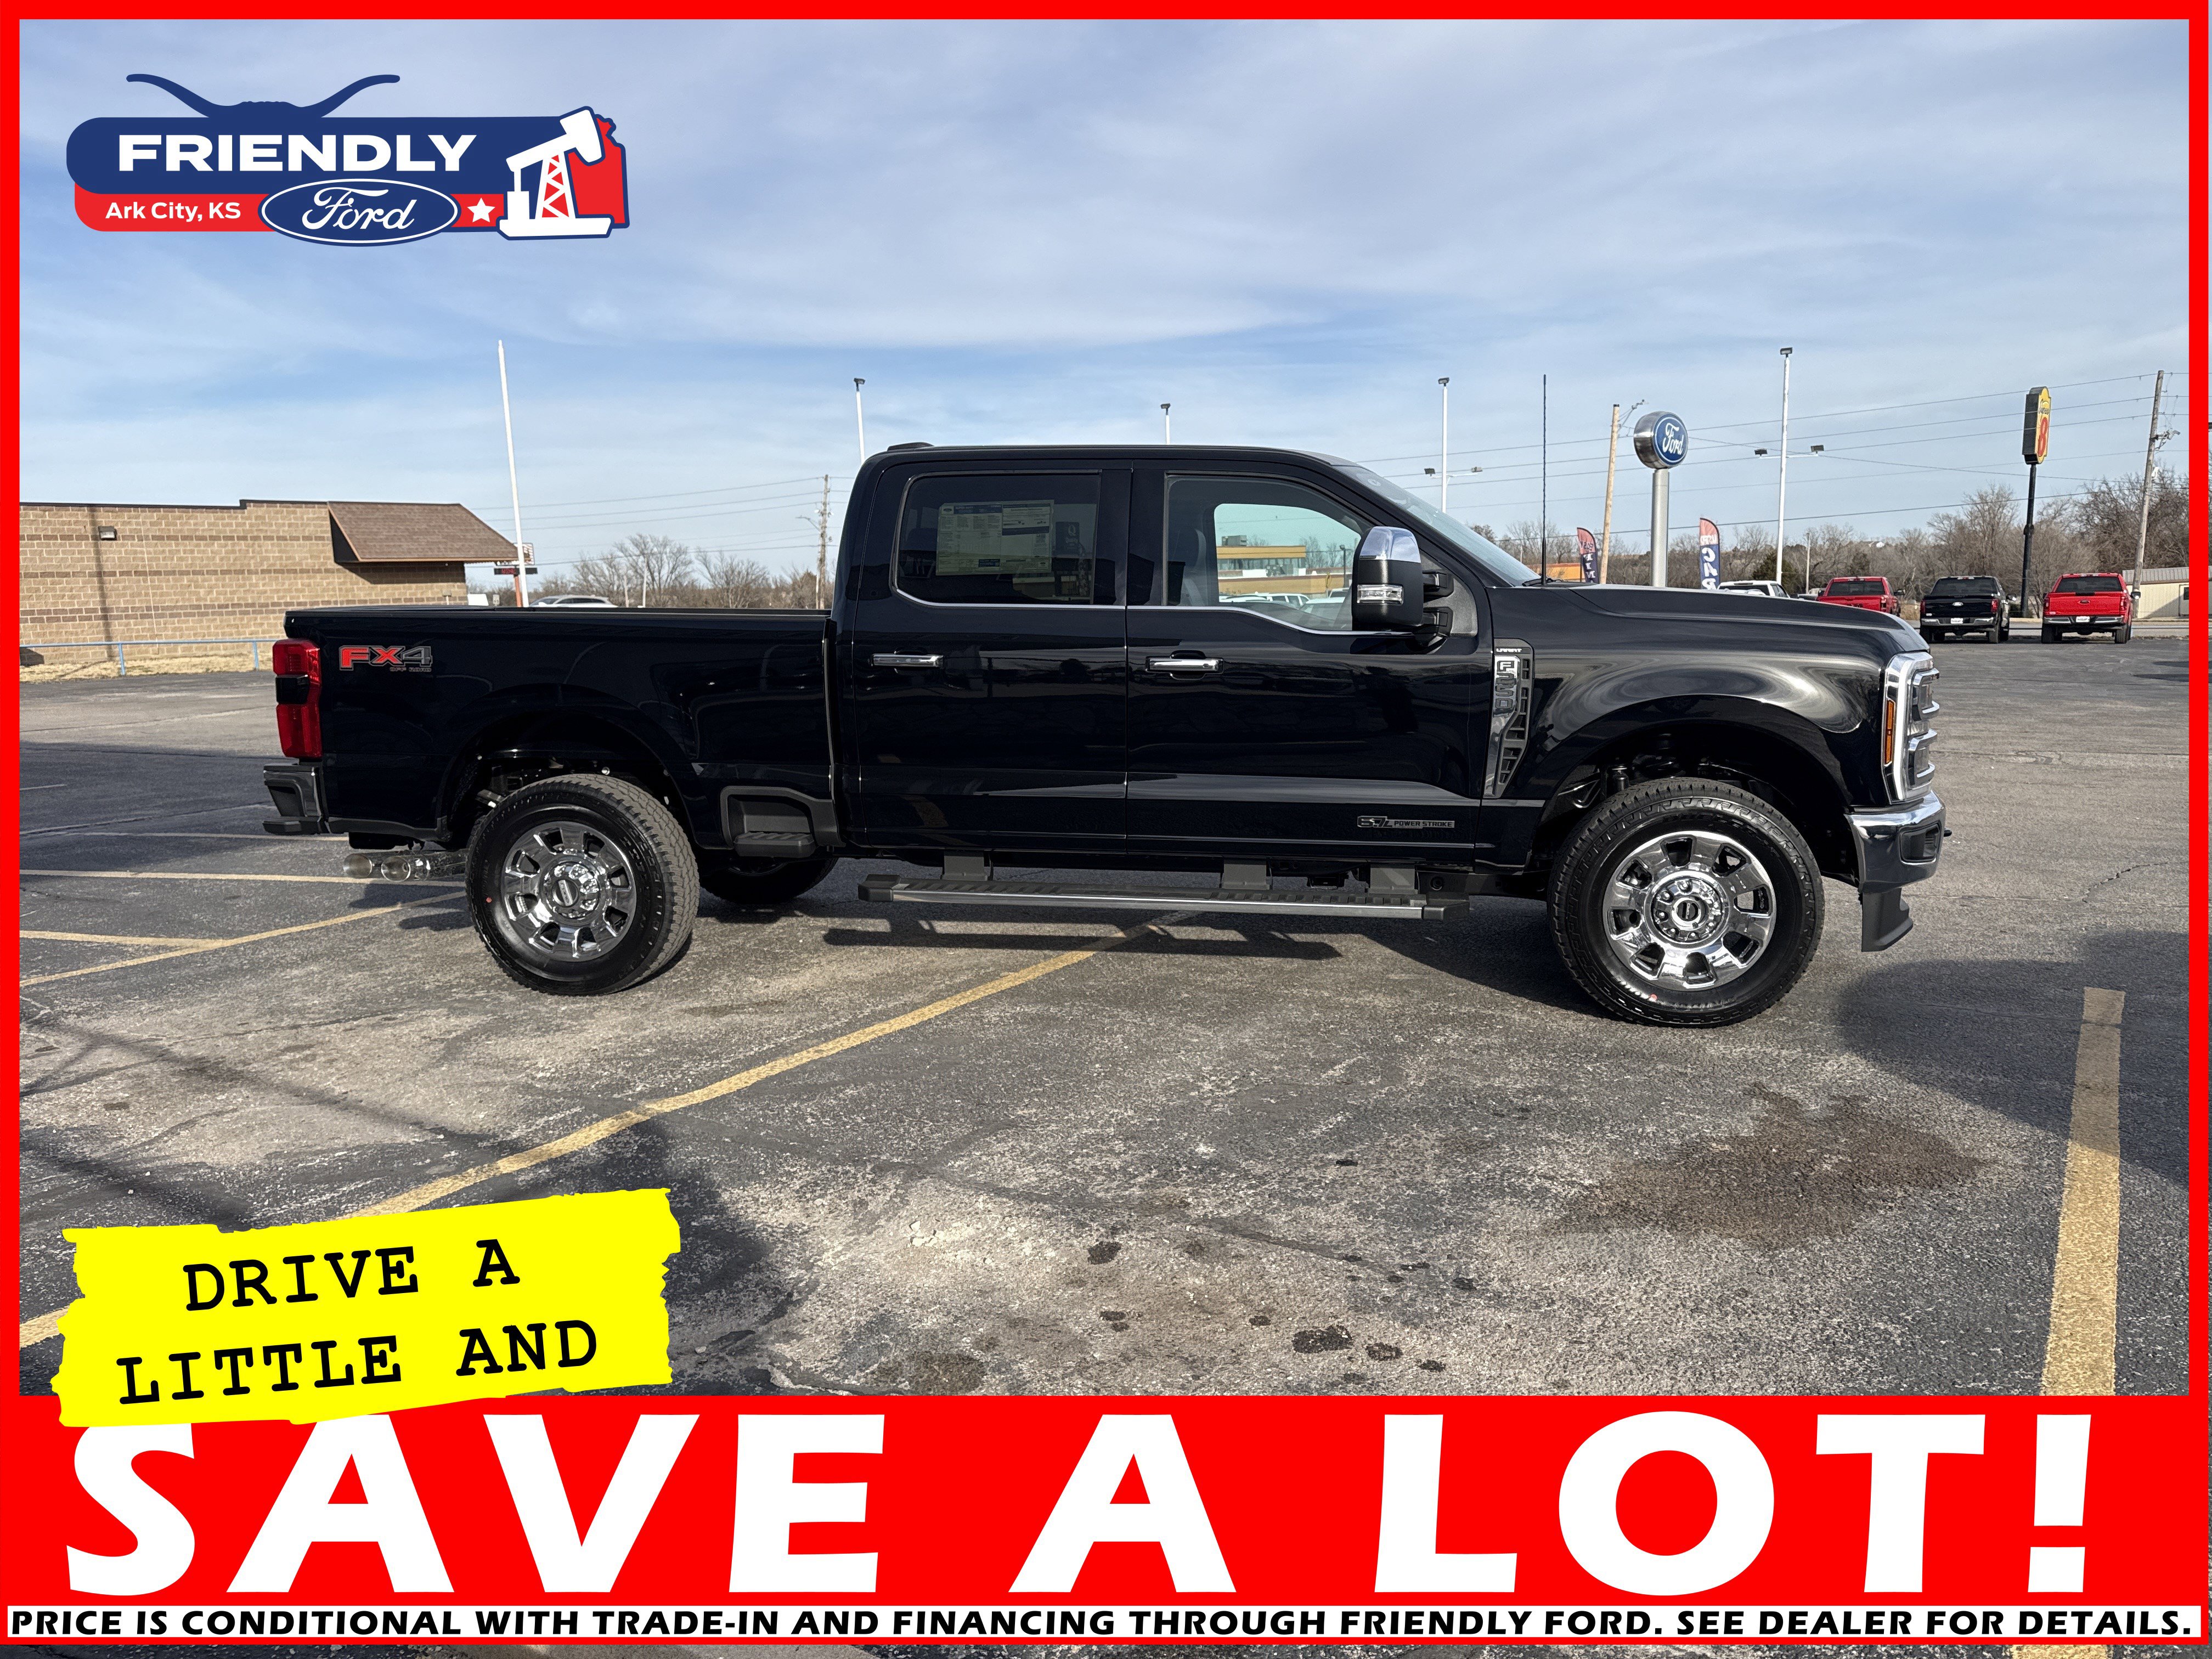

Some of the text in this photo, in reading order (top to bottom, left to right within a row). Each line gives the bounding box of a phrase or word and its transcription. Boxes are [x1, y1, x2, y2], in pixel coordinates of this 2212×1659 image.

[1662, 422, 1684, 455] Ford
[2038, 417, 2048, 456] 8
[339, 645, 432, 670] FX4
